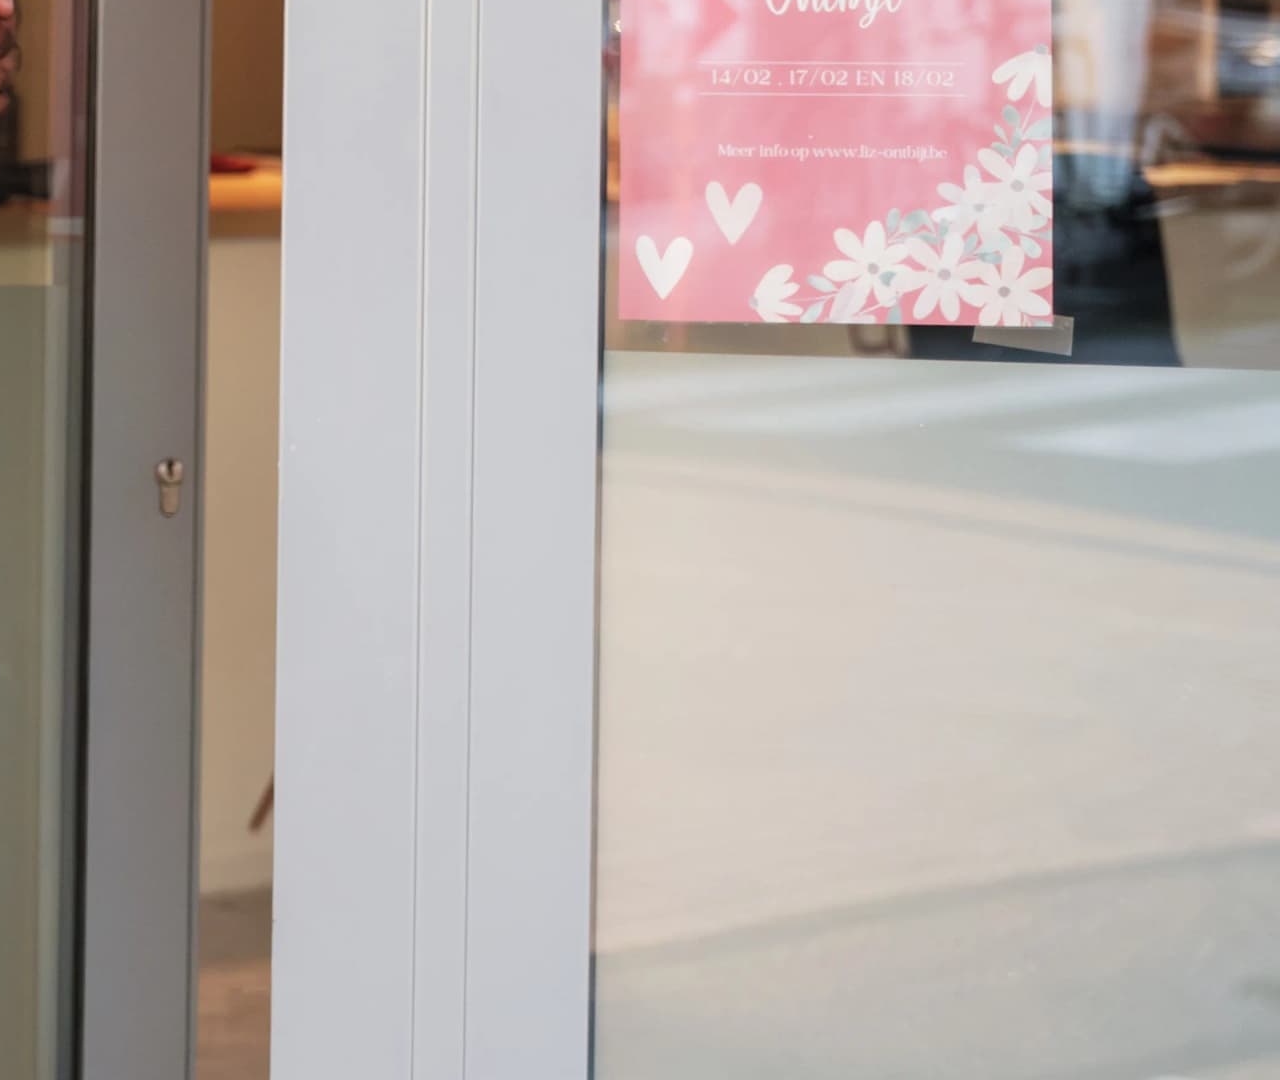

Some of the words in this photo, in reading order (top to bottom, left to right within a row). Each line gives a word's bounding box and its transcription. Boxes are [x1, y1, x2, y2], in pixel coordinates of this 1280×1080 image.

[711, 68, 772, 87] 14/02
[789, 68, 849, 87] 17/02
[855, 68, 886, 87] EN
[894, 69, 955, 88] 18/02
[718, 143, 756, 158] Meer
[759, 143, 789, 158] info
[791, 146, 810, 162] op
